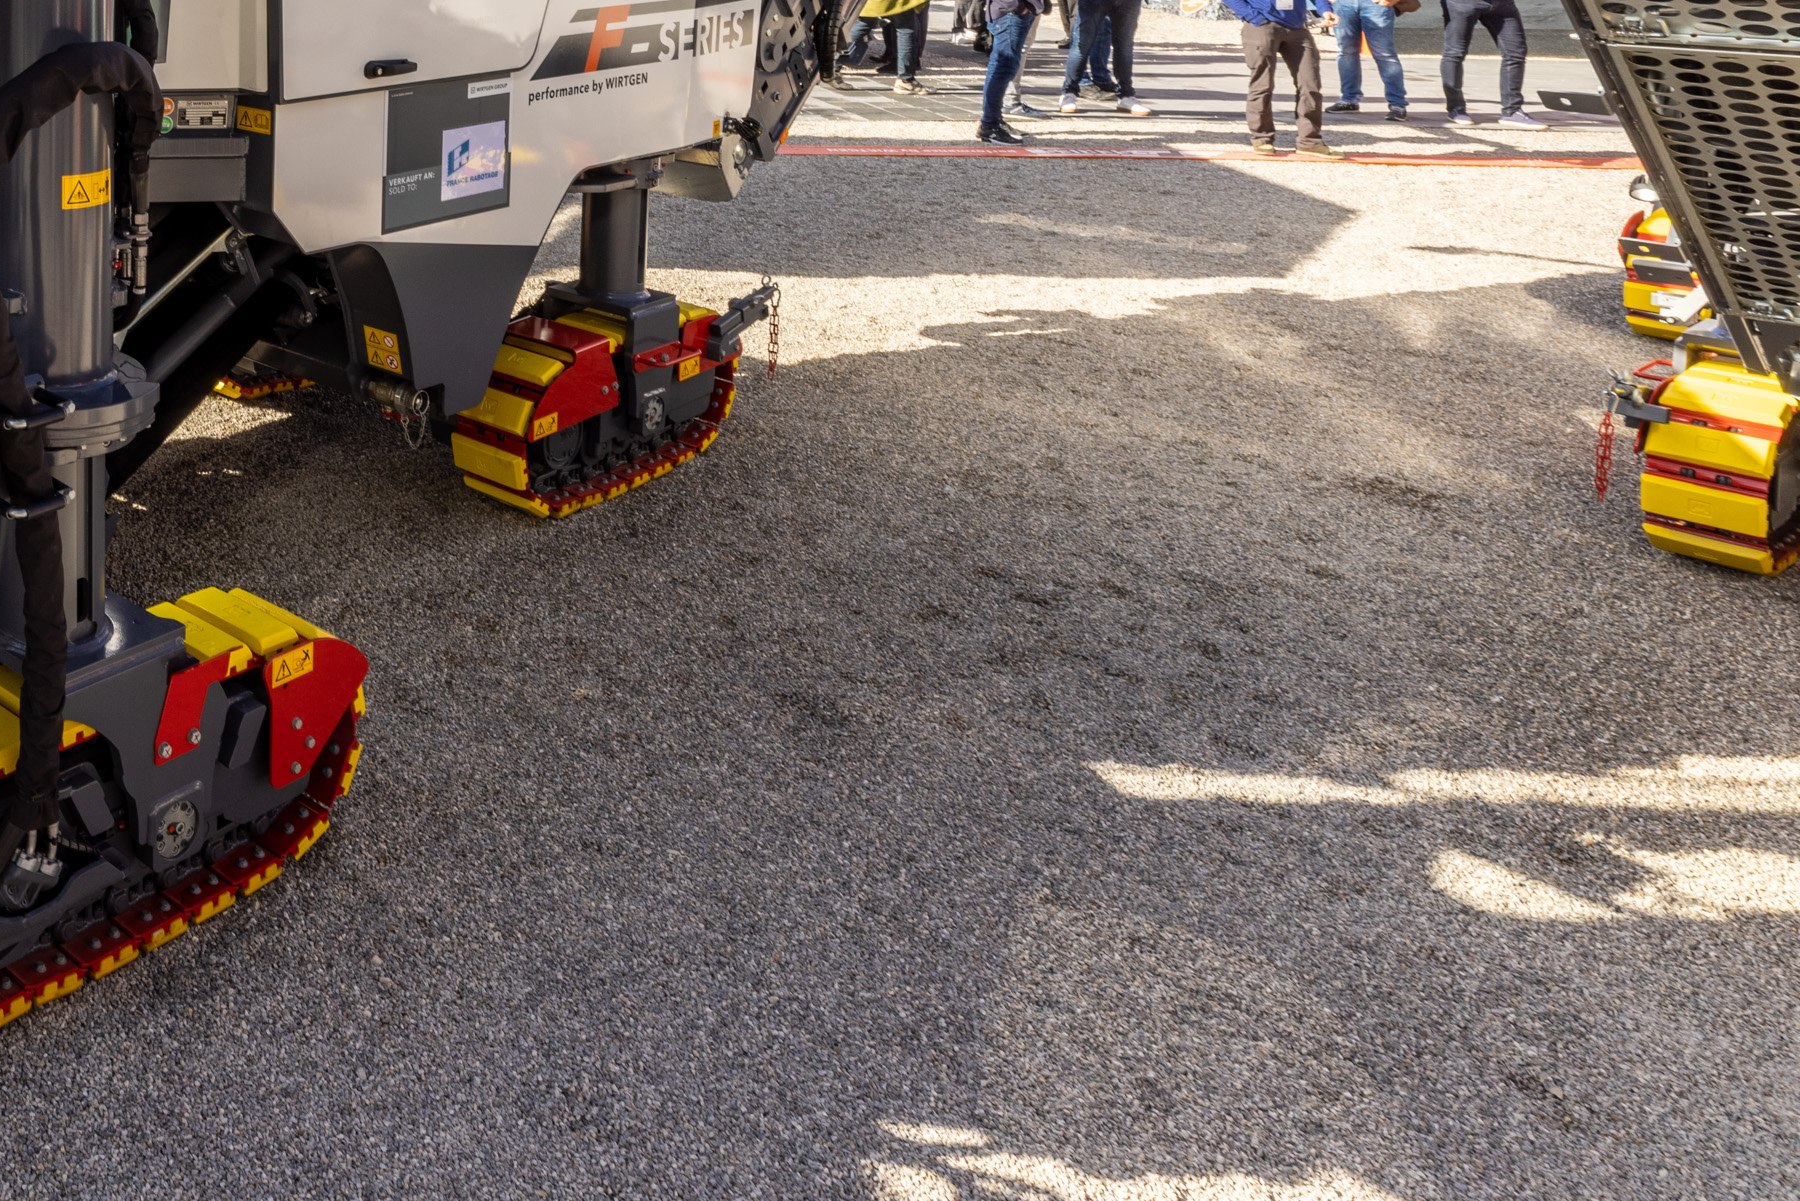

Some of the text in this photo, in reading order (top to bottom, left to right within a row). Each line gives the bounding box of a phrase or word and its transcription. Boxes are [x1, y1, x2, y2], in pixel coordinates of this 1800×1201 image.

[528, 72, 649, 106] performance by WIRTGEN
[388, 170, 436, 187] VERKAUFT AN:
[388, 182, 418, 195] SOLD TO:
